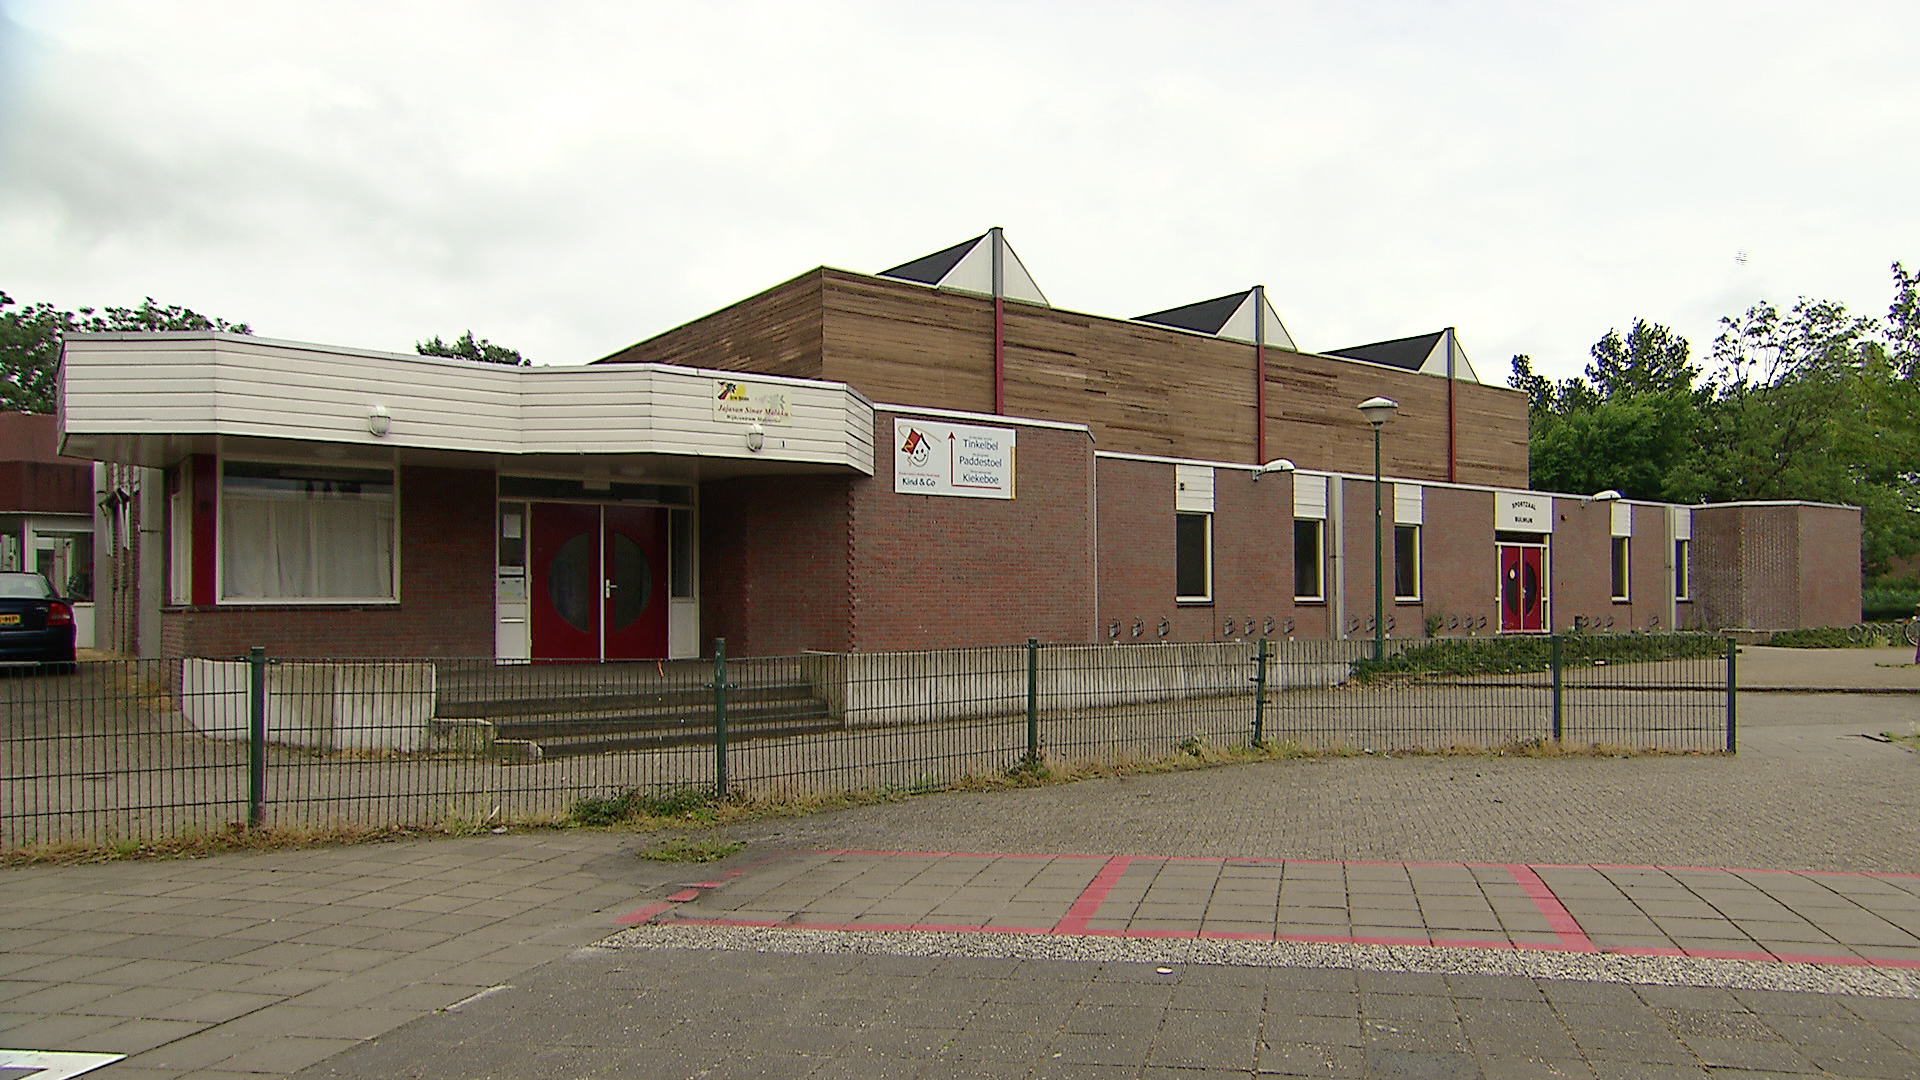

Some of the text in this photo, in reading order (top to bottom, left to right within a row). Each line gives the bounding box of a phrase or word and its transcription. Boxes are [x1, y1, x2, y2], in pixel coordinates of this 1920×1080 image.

[963, 439, 998, 450] Tinkelbel
[959, 455, 1002, 467] Paddestoel
[902, 477, 936, 487] Kind & Co
[962, 473, 999, 485] Kiekeboe
[1511, 501, 1536, 510] SPORTZAAL
